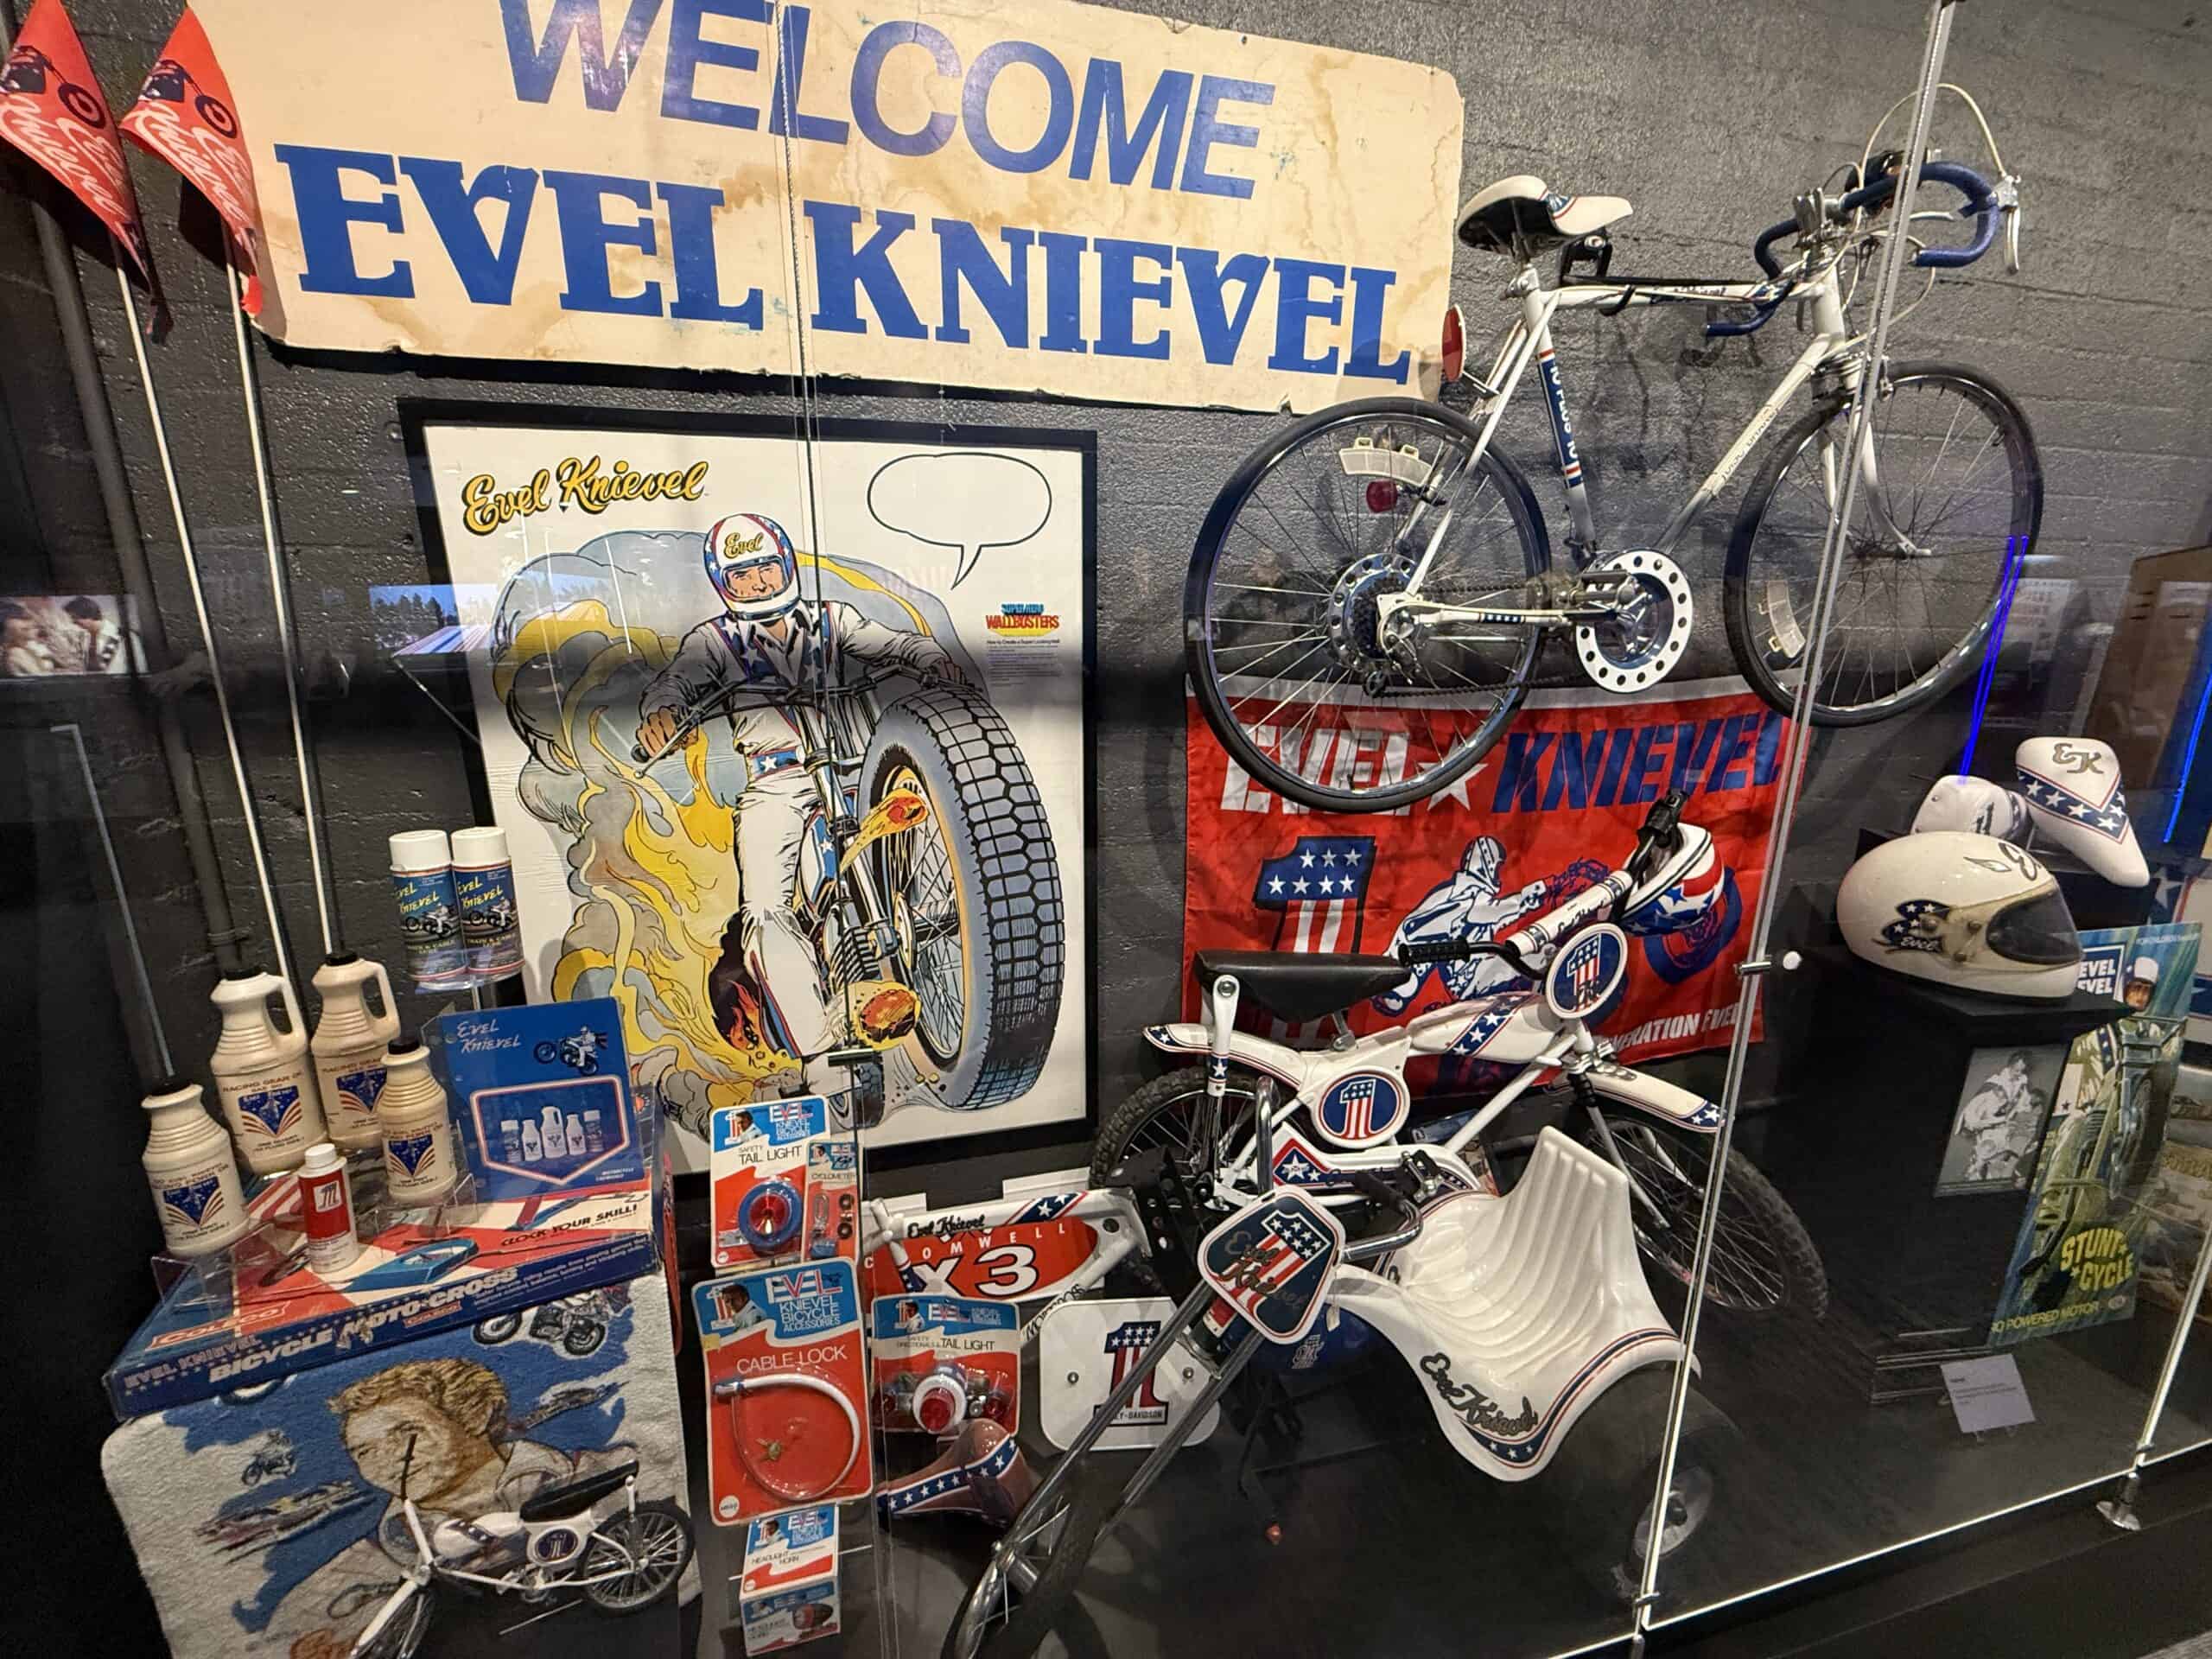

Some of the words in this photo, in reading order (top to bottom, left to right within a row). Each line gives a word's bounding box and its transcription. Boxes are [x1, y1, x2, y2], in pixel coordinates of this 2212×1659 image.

[499, 0, 1276, 200] WELCOME
[274, 143, 764, 331] EVEL
[804, 200, 1412, 386] KNIEVEL
[461, 469, 551, 536] Evel
[556, 455, 709, 515] Knievel
[724, 532, 764, 559] Evel
[985, 614, 1060, 630] WALLBUSTERS
[1491, 709, 1784, 814] KNIEVEL
[740, 1152, 764, 1166] TAIL
[767, 1145, 803, 1161] LIGHT
[500, 1230, 547, 1247] CLOCK
[552, 1217, 591, 1234] YOUR
[595, 1205, 638, 1221] SKILL!
[907, 1222, 935, 1238] Evel
[936, 1214, 987, 1235] Knievel
[2060, 1228, 2126, 1271] STUNT
[766, 1268, 843, 1304] EVEL
[2078, 1252, 2135, 1292] CYCLE
[779, 1298, 837, 1314] KNIEVEL
[780, 1306, 841, 1325] BICYCLE
[2005, 1309, 2060, 1330] POWERED
[782, 1316, 842, 1333] ACCESSORIES
[178, 1334, 263, 1368] KNIEVEL
[209, 1328, 334, 1383] BICYCLE
[736, 1352, 796, 1376] CABLE
[797, 1345, 849, 1368] LOCK
[940, 1338, 962, 1349] TAIL
[963, 1339, 995, 1351] LIGHT
